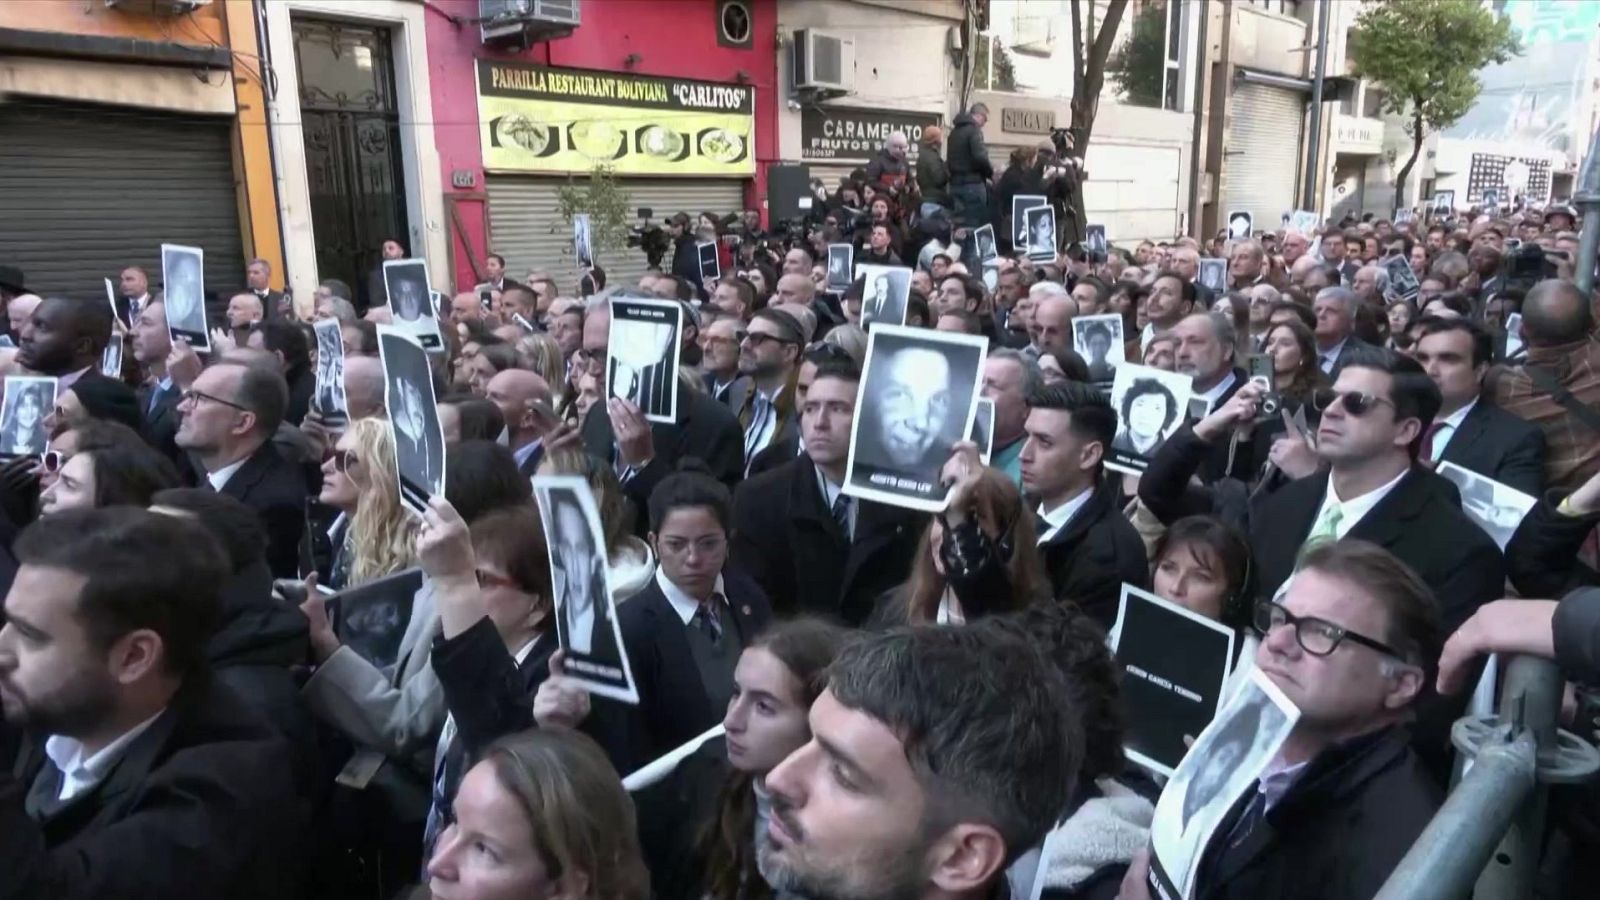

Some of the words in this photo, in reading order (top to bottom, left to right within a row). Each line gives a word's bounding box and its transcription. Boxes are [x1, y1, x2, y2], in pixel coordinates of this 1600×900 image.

[491, 66, 547, 92] PARRILLA
[547, 72, 616, 98] RESTAURANT
[617, 79, 668, 102] BOLIVIANA
[811, 137, 870, 151] FRUTOS
